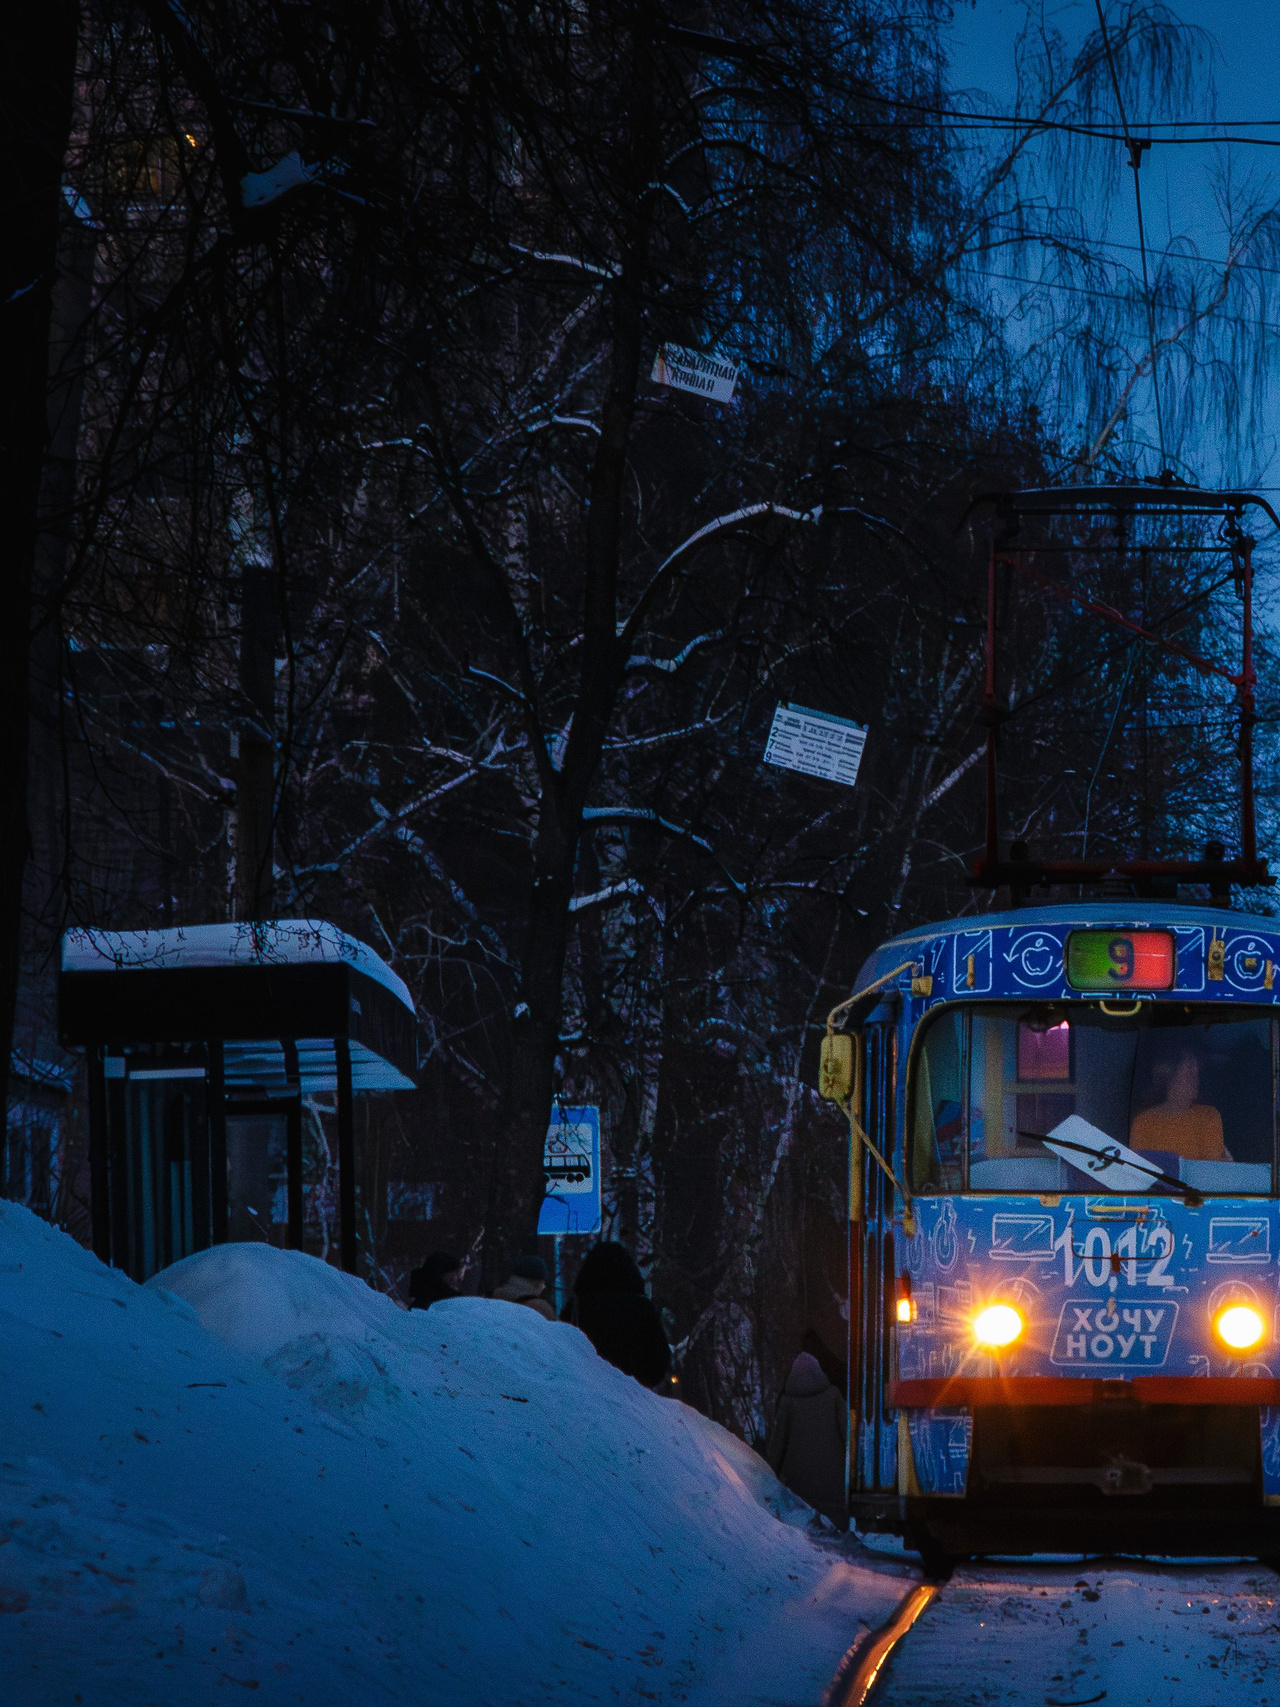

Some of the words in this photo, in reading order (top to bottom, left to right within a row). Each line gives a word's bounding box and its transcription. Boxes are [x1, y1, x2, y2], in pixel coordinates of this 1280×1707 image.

[1108, 938, 1135, 981] 9
[1087, 1146, 1121, 1172] 9
[1054, 1226, 1175, 1287] 1012
[1072, 1307, 1165, 1333] ХОЧУ
[1066, 1333, 1158, 1359] НОУТ
